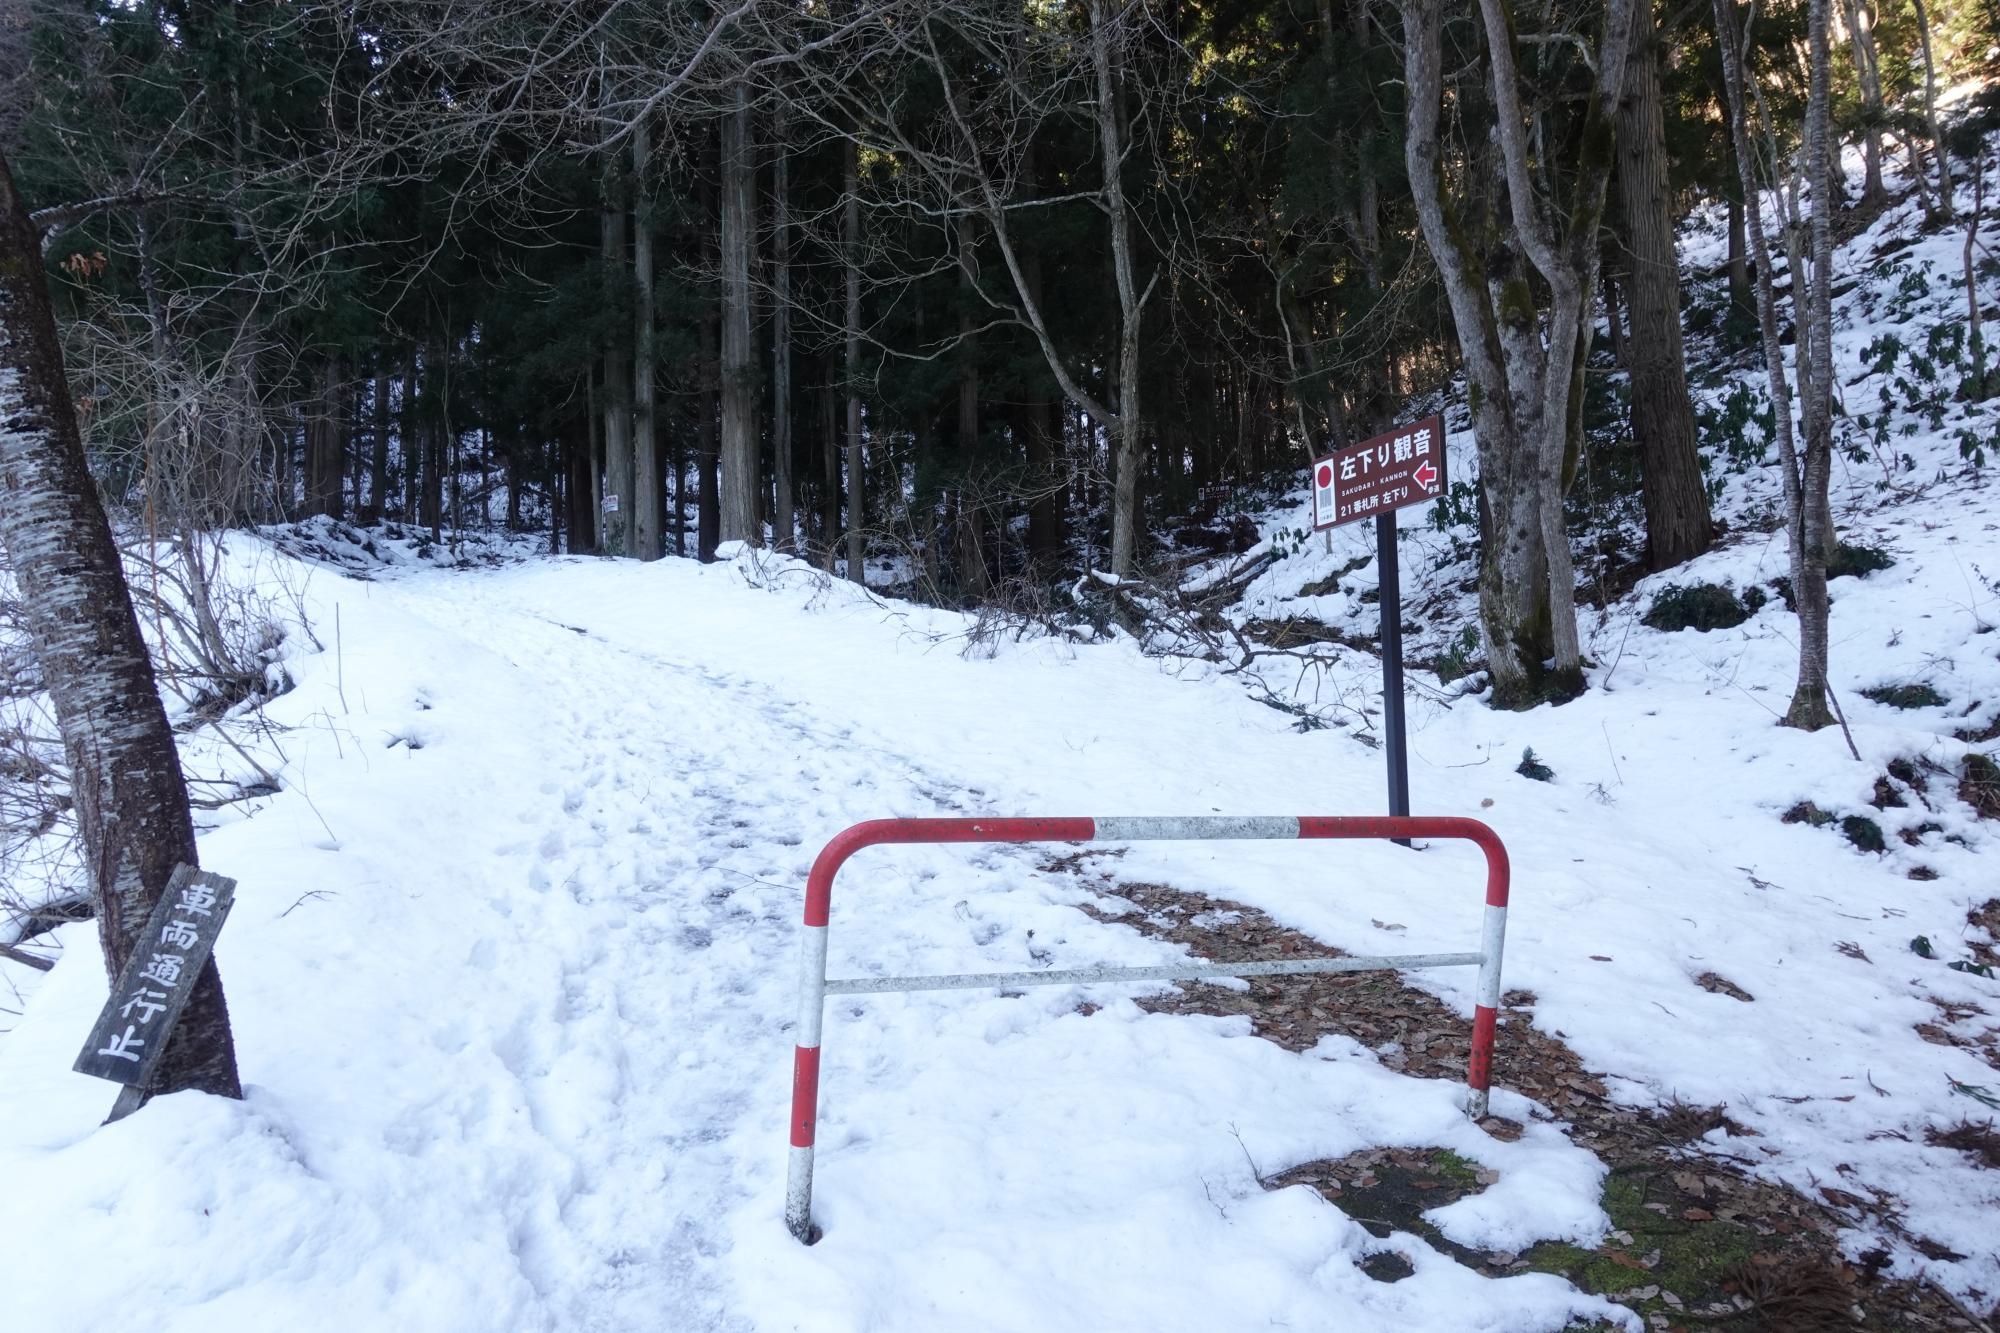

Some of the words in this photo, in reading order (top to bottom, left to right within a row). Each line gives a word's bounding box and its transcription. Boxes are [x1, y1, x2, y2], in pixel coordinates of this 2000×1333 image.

[1340, 428, 1431, 480] 左下り観音
[1341, 481, 1375, 497] SAKUDARI
[1380, 470, 1408, 484] KANNON
[1341, 494, 1379, 517] 21番札所
[1382, 485, 1408, 504] 左下り
[98, 883, 216, 1062] 車両通行止
